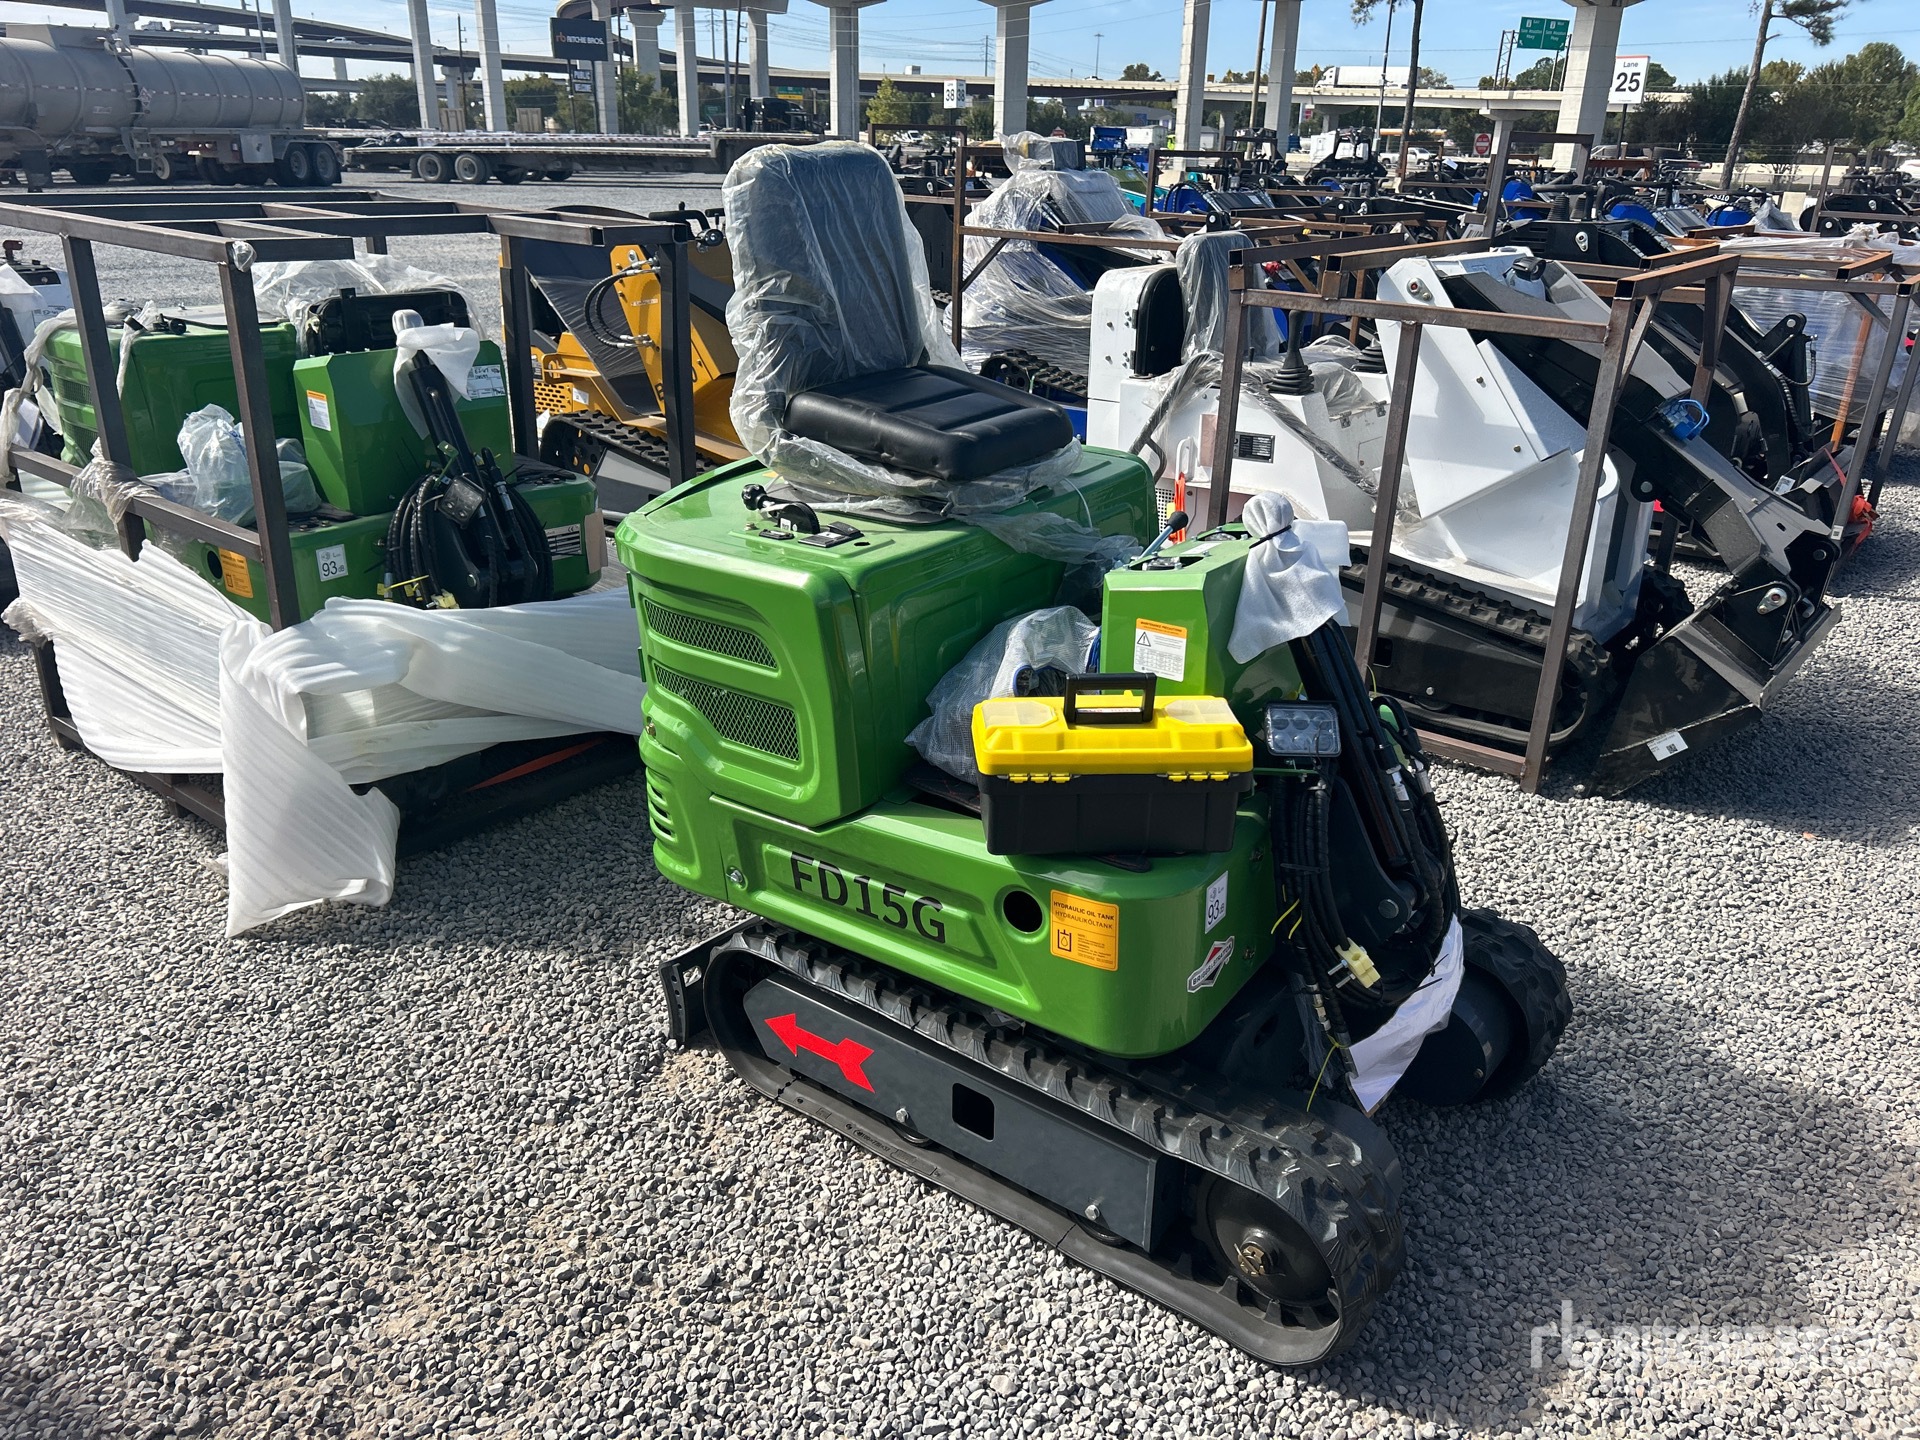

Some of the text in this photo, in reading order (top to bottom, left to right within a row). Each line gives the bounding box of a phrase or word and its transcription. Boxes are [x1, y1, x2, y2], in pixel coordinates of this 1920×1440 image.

[1615, 72, 1641, 92] 25
[945, 89, 955, 102] 38
[957, 89, 965, 102] 38
[322, 561, 338, 577] 93
[791, 851, 945, 943] FD15G
[1053, 901, 1115, 921] HYDRAULIC OIL TANK
[1208, 899, 1220, 925] 93
